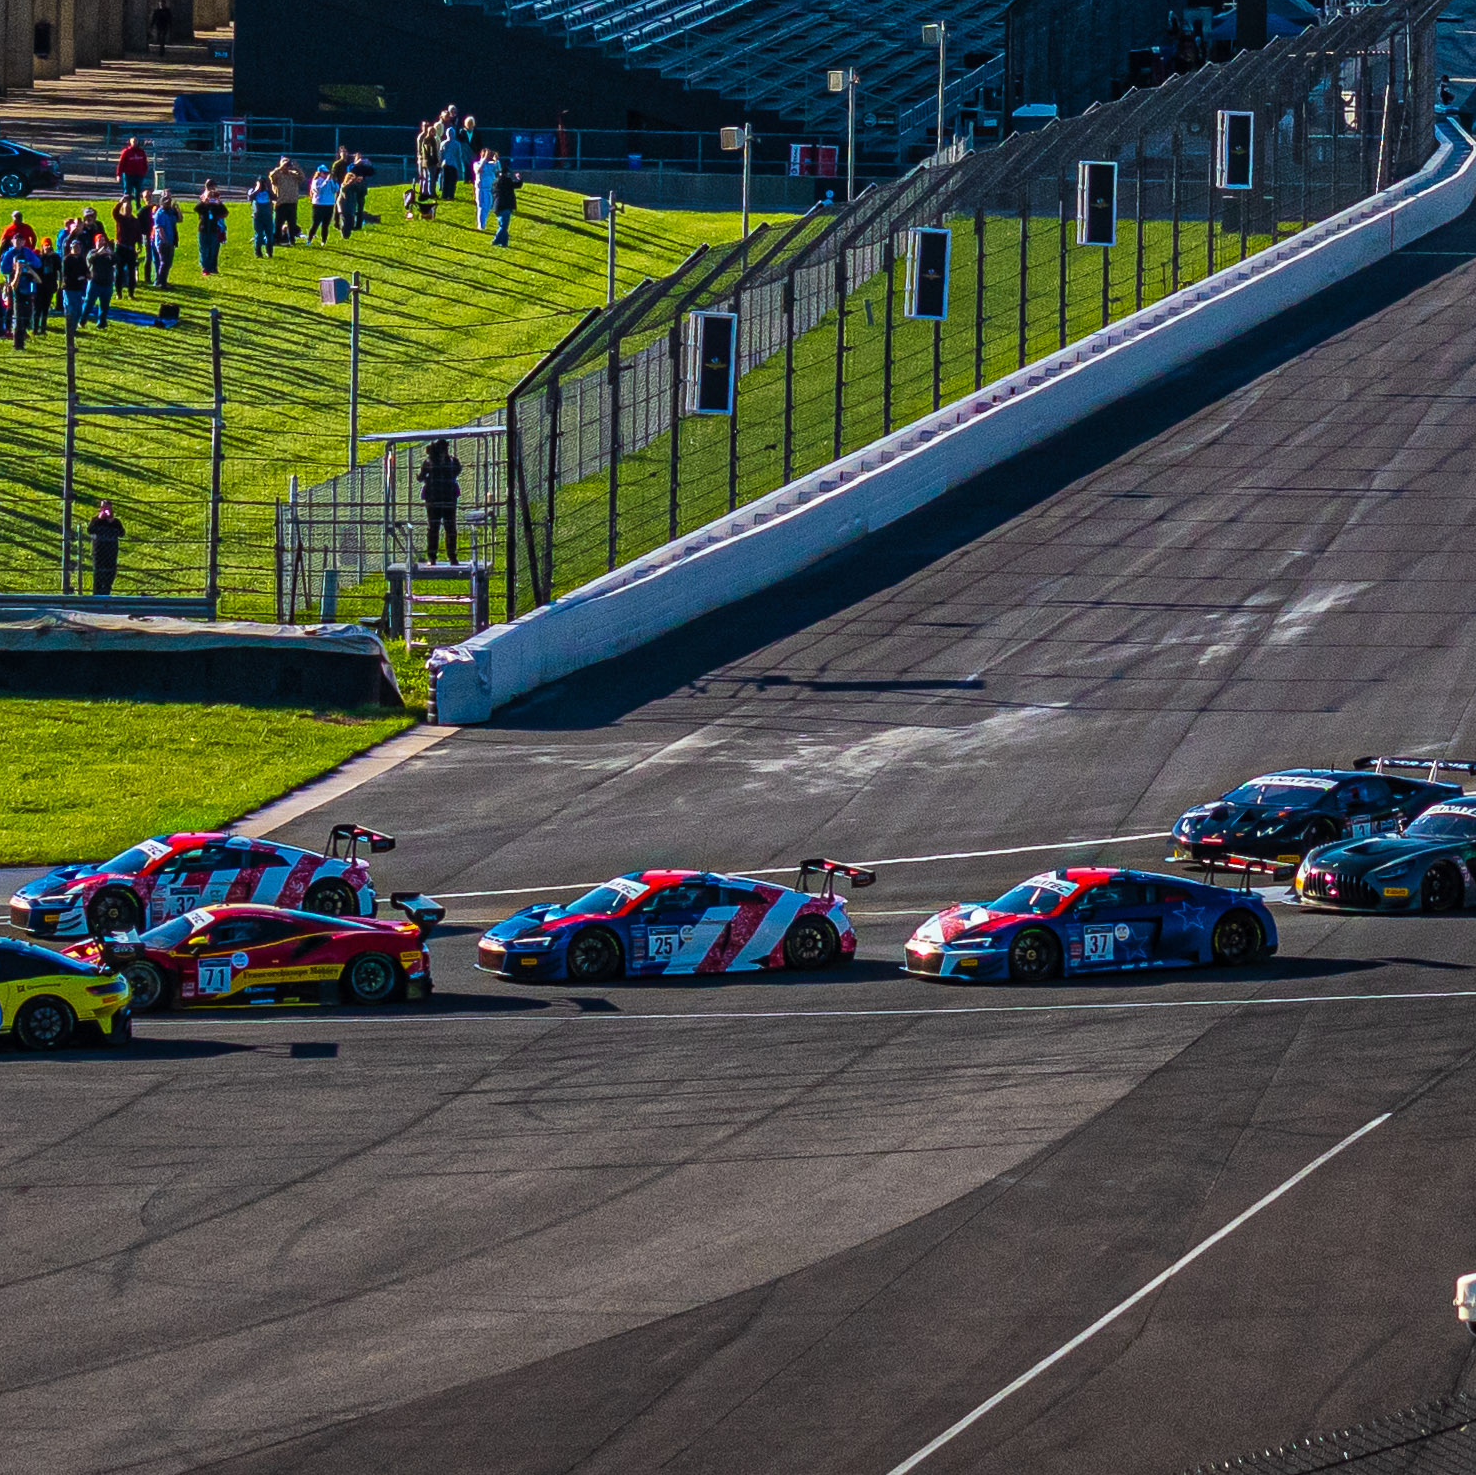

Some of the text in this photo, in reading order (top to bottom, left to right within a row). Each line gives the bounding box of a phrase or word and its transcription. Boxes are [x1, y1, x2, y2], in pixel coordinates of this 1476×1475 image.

[176, 897, 196, 914] 32
[655, 937, 673, 955] 25
[1090, 935, 1108, 954] 37
[205, 968, 225, 987] 71
